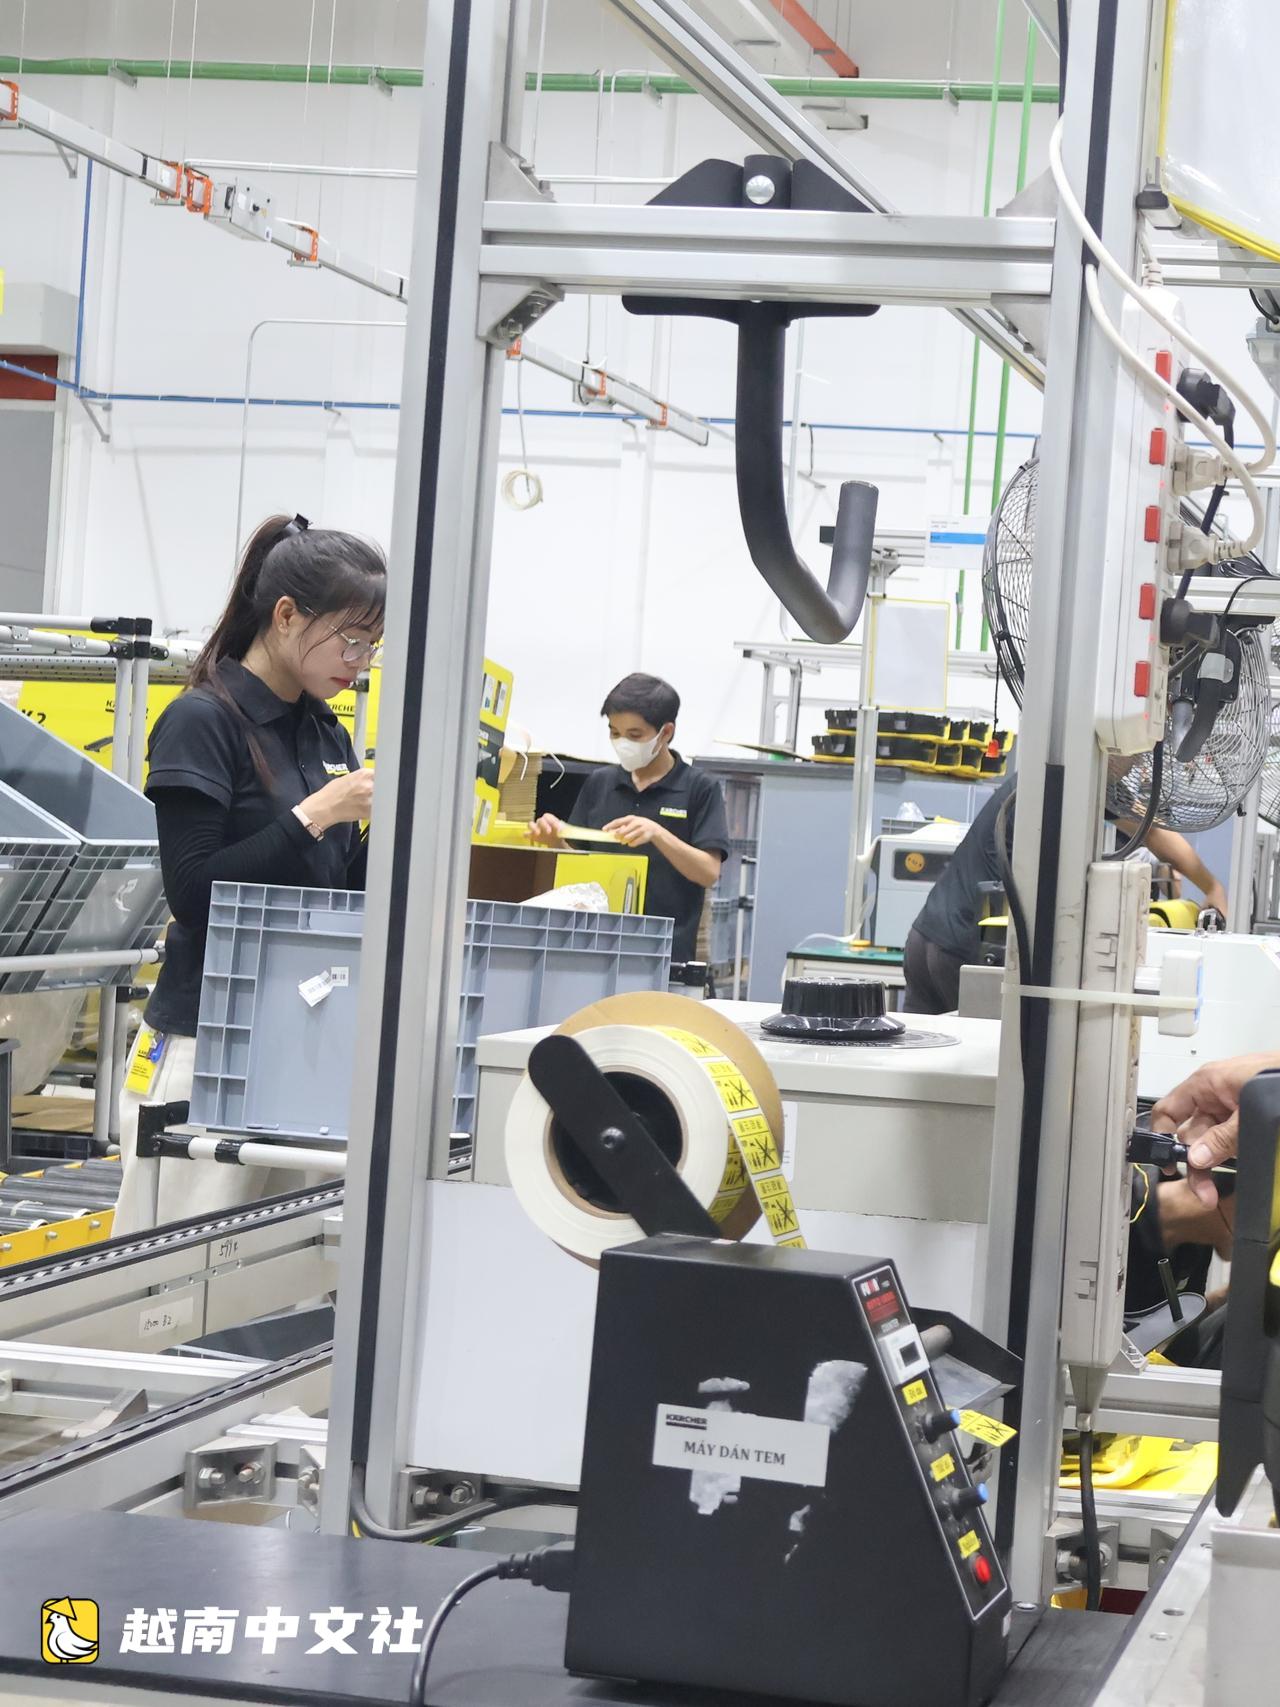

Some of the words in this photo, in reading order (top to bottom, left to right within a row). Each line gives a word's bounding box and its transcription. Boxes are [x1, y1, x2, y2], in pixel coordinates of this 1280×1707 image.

[684, 1440, 716, 1456] MÁY
[720, 1443, 750, 1461] DÁN
[755, 1450, 786, 1466] TEM
